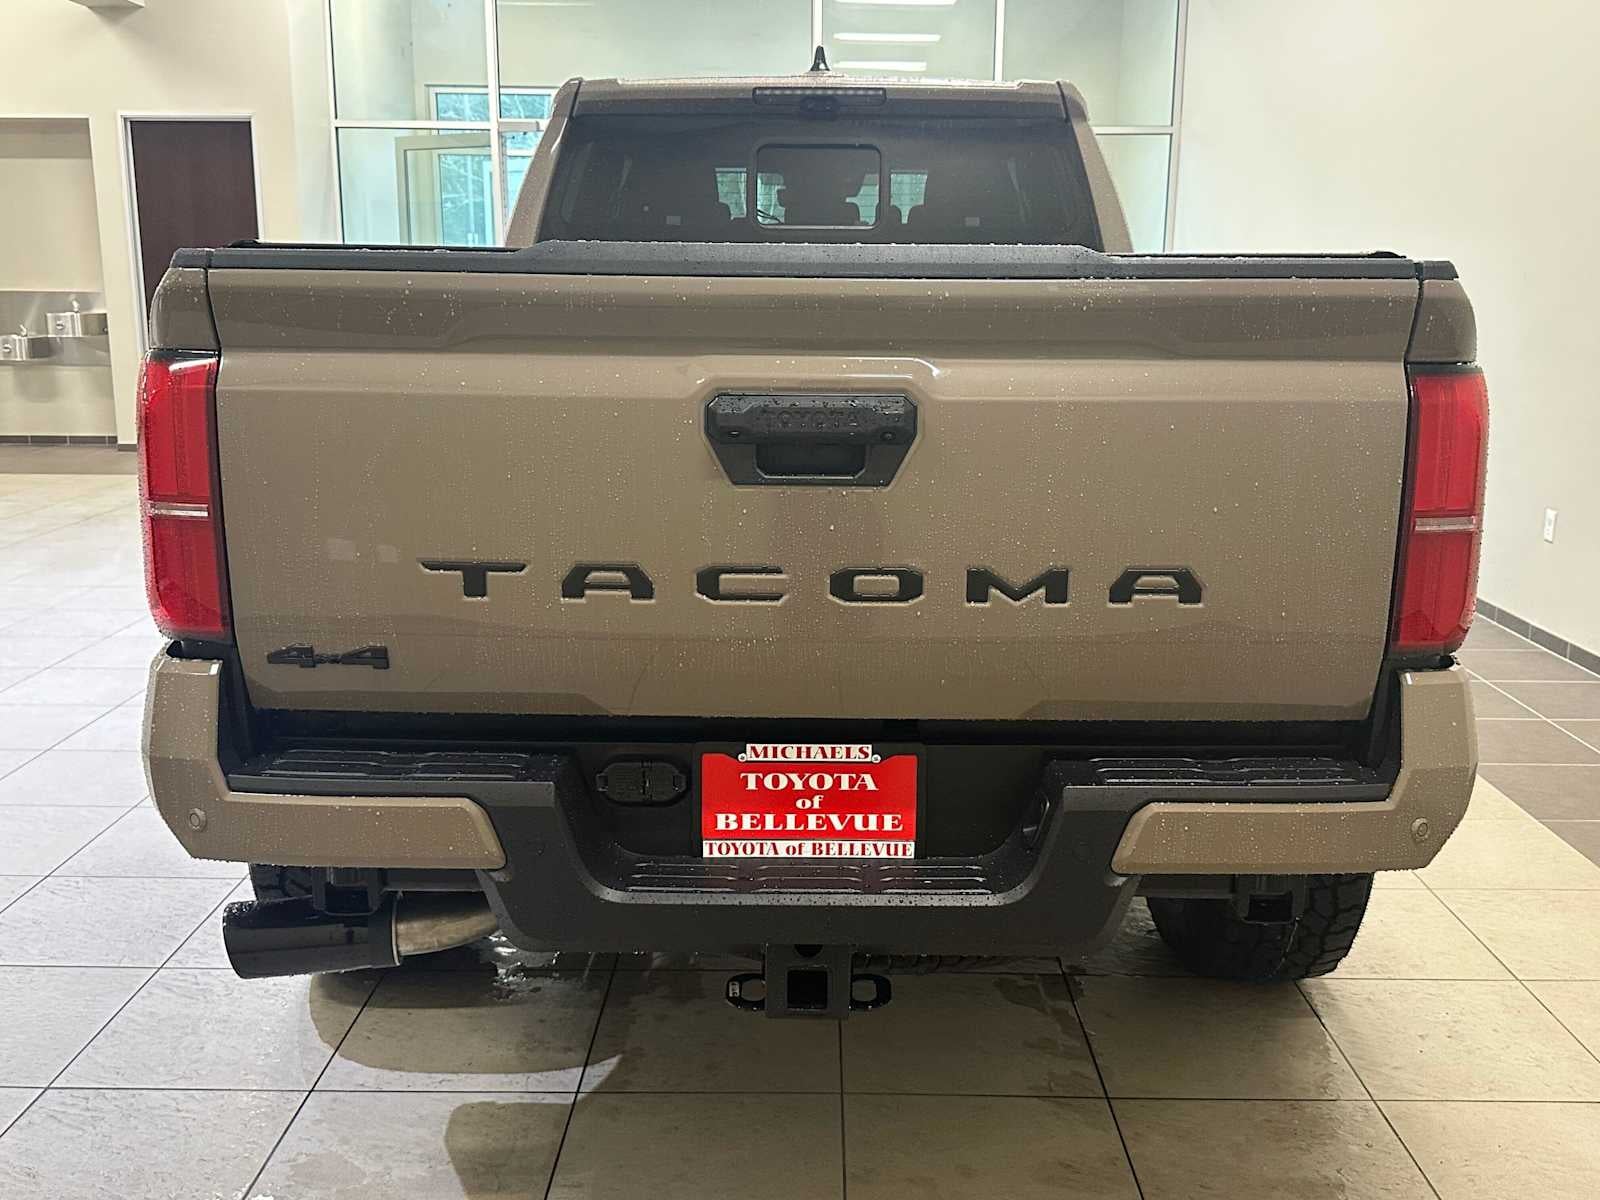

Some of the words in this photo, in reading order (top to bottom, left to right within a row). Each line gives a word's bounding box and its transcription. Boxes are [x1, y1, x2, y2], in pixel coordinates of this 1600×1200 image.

[418, 560, 1206, 607] TACOMA
[748, 745, 871, 760] MICHAELS
[740, 772, 879, 791] TOYOTA
[795, 795, 825, 810] of
[714, 813, 904, 832] BELLEVUE
[704, 841, 780, 856] TOYOTA
[785, 841, 805, 856] of
[811, 842, 913, 857] BELLEVUE
